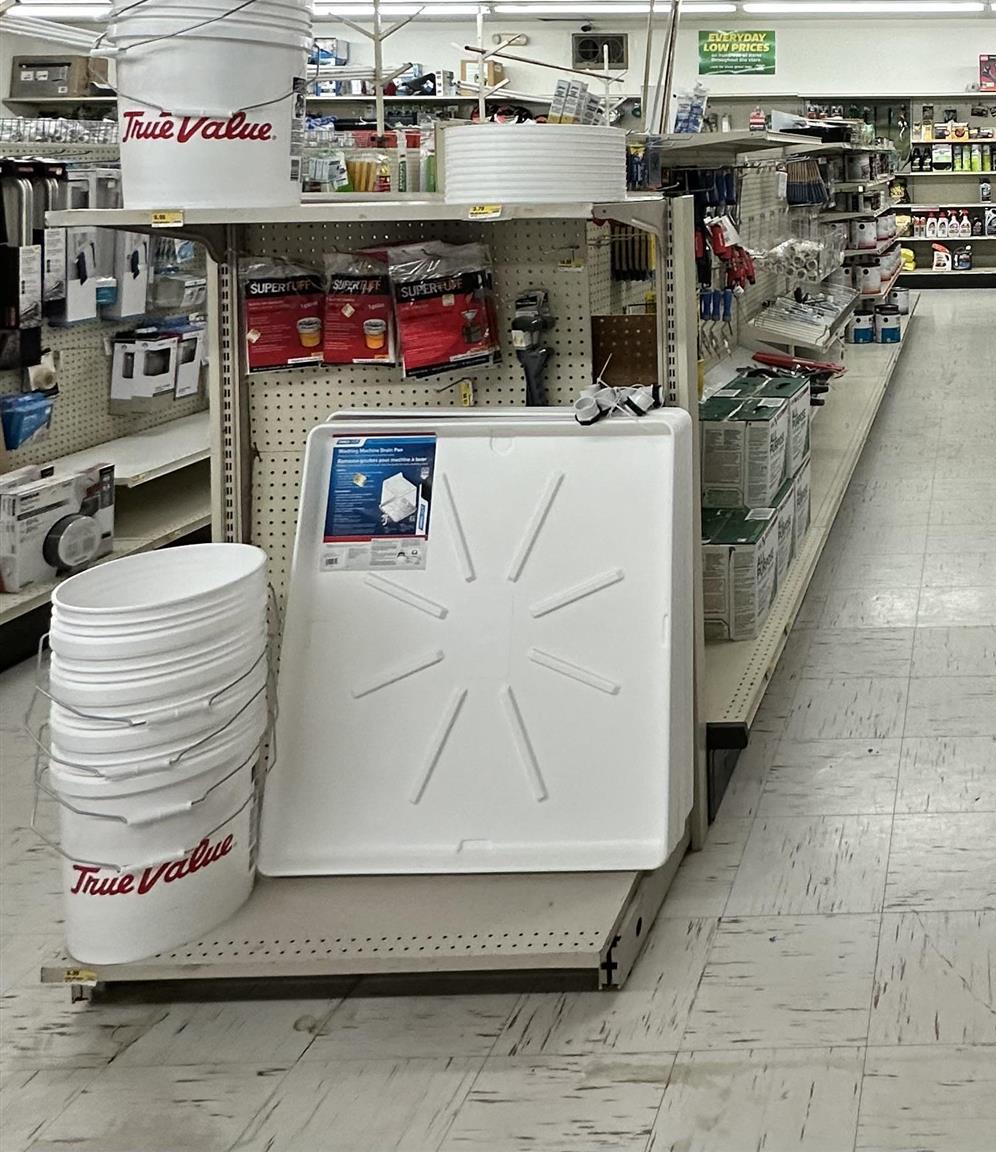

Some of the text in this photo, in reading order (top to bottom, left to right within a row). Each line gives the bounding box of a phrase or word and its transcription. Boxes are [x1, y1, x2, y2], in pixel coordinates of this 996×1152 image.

[708, 33, 767, 42] EVERYDAY
[703, 43, 770, 52] LOW PRICES
[122, 111, 273, 144] True Value
[250, 278, 312, 295] SUPERTUFF
[71, 833, 234, 896] True Value
